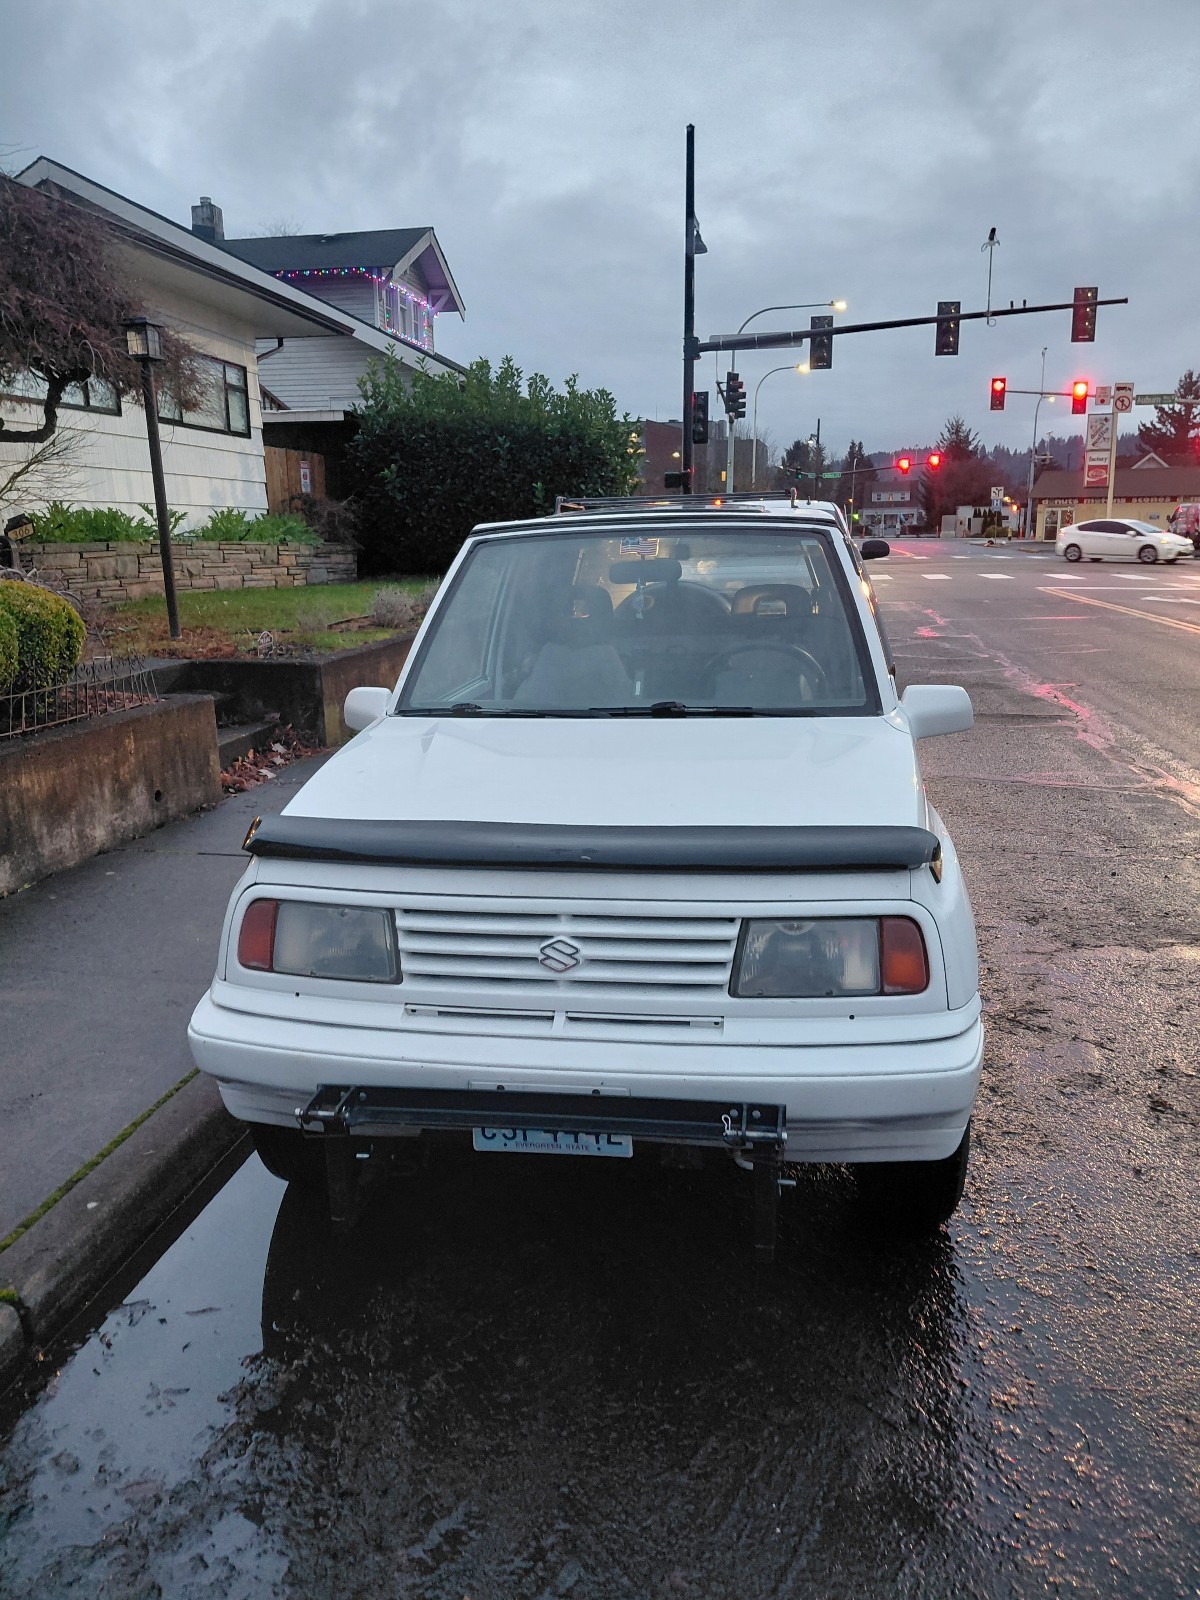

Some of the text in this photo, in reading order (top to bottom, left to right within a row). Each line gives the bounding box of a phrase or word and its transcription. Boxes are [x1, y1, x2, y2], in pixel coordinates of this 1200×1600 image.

[1136, 395, 1162, 404] Auburn
[13, 526, 30, 539] 306
[515, 1141, 590, 1151] EVERGREEN STATE
